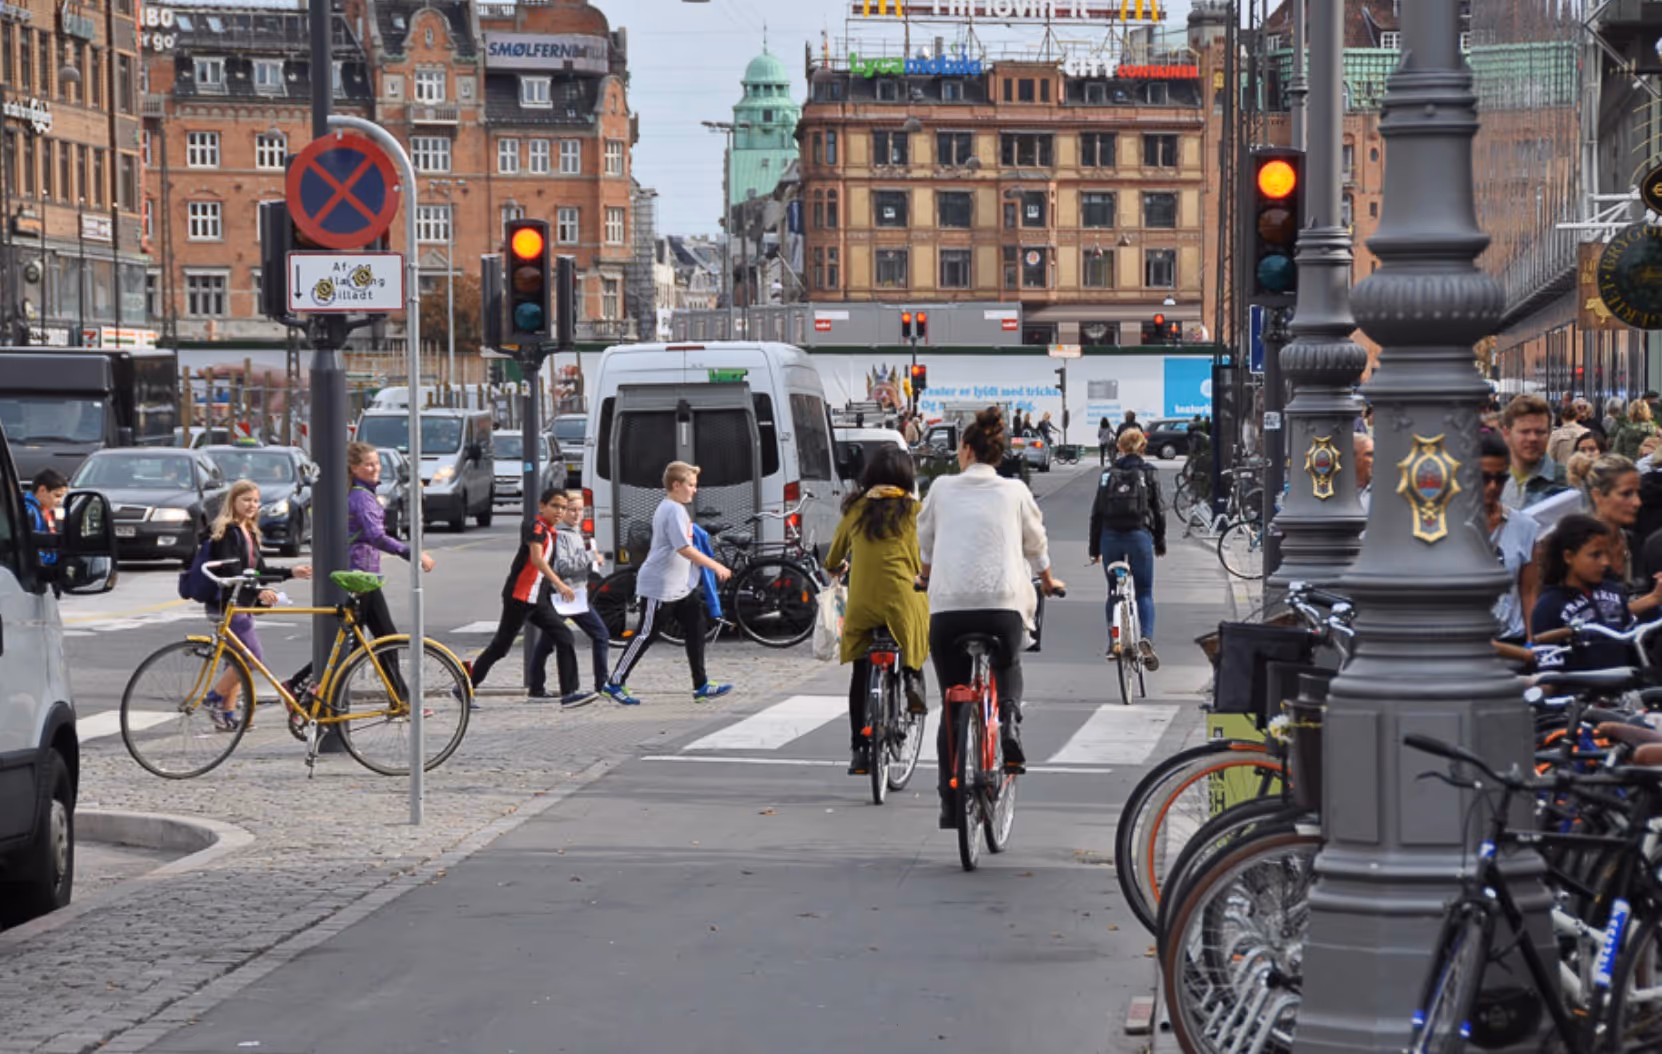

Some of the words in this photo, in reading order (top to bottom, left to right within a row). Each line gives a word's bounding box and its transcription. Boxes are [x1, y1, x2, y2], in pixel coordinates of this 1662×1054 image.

[932, 0, 976, 16] Im
[984, 0, 1056, 18] lovin
[1117, 64, 1200, 79] CONTAINER
